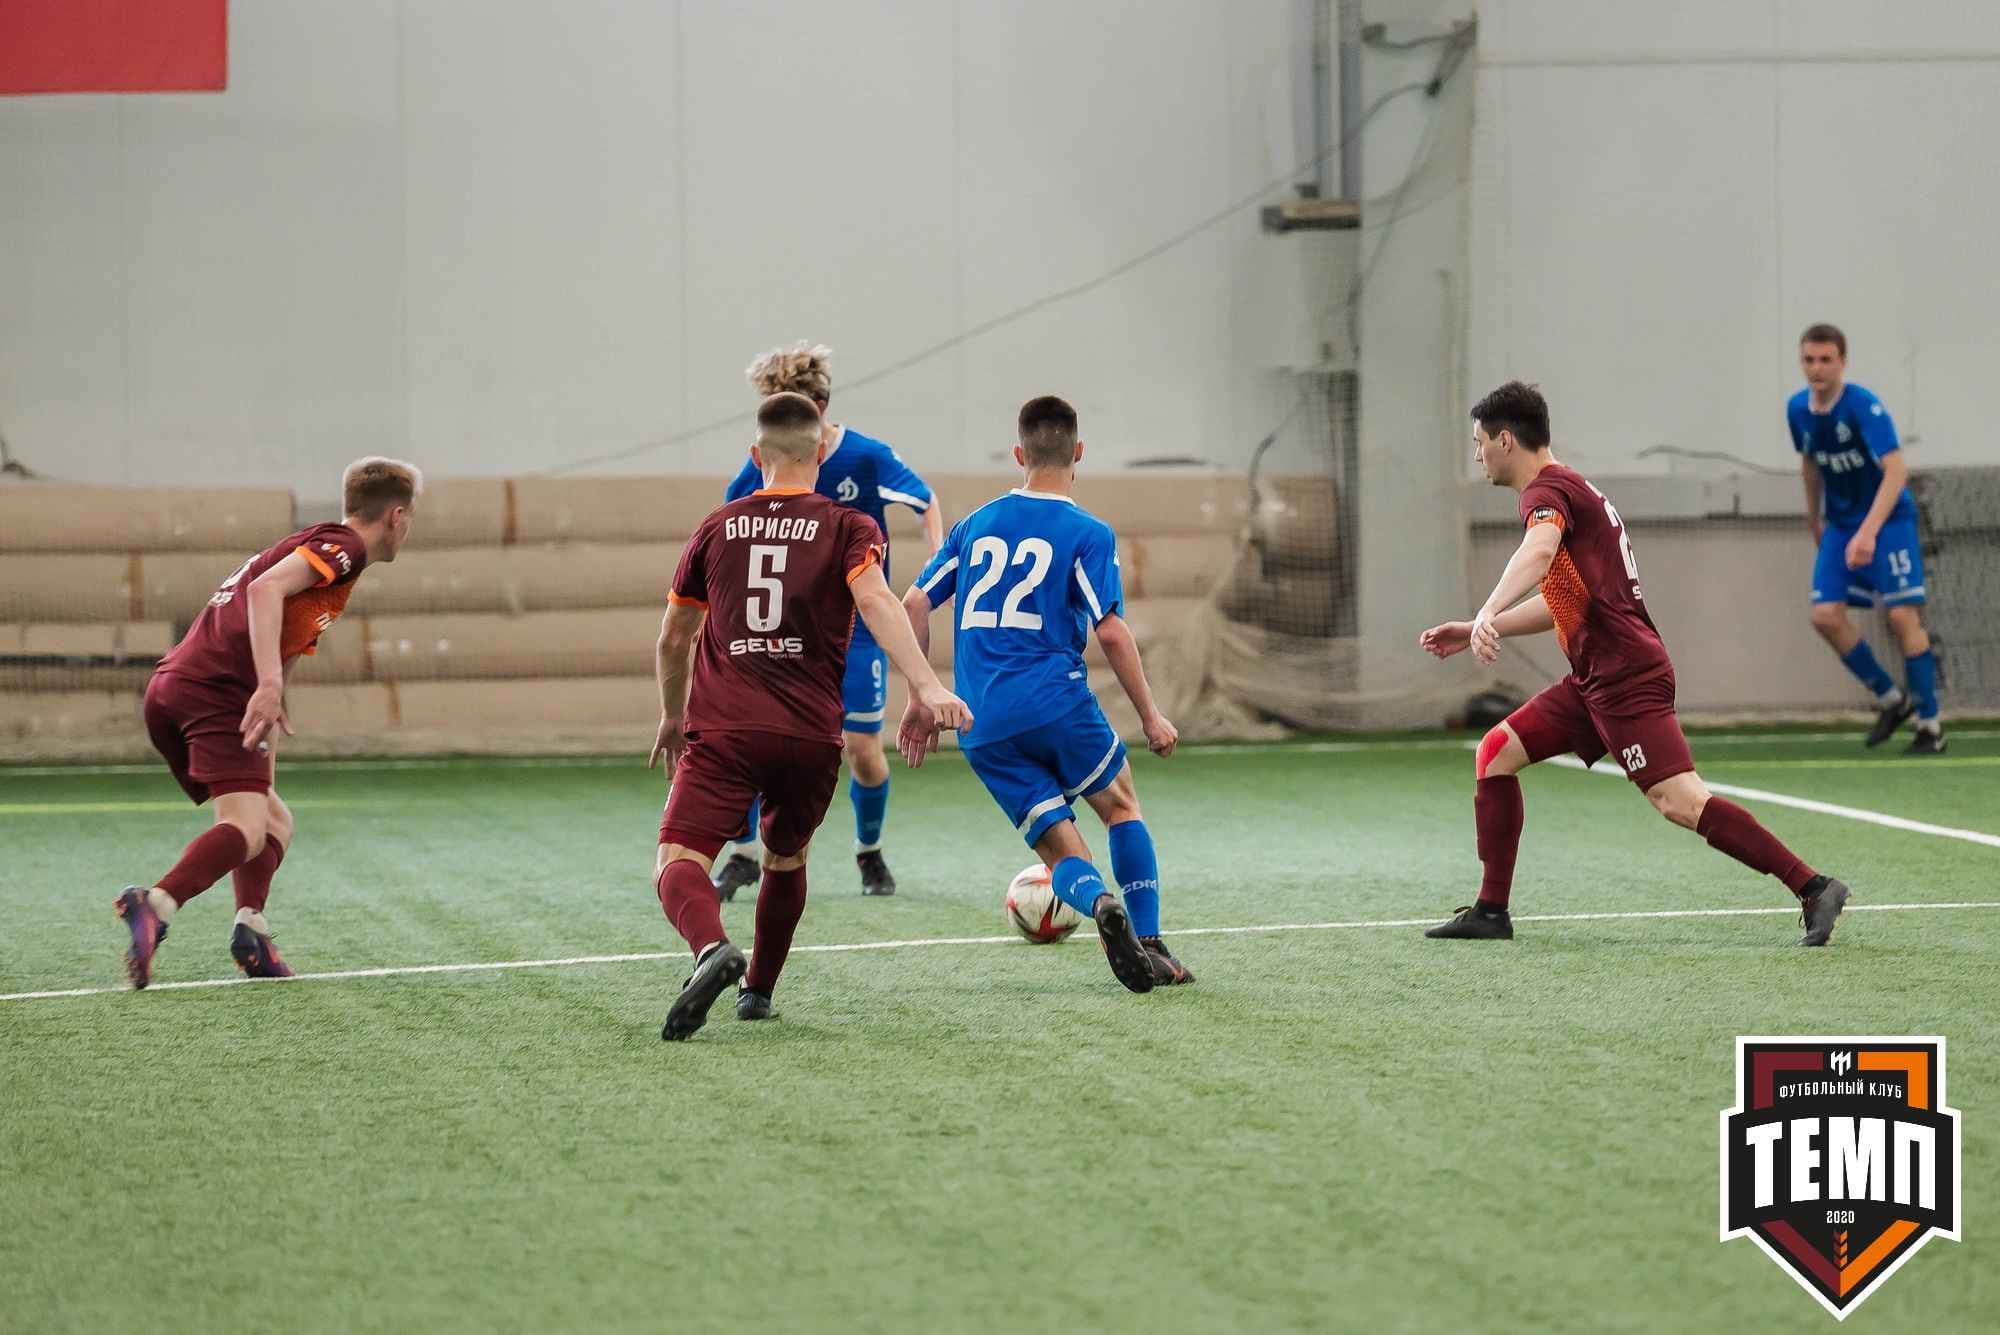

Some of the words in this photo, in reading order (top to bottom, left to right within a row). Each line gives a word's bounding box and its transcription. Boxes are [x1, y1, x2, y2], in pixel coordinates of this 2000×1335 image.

[725, 515, 820, 542] БОРИСОВ
[1888, 549, 1911, 576] 15
[746, 544, 788, 632] 5
[960, 535, 1053, 631] 22
[729, 637, 803, 656] SEUS
[872, 659, 882, 689] 9
[1622, 743, 1648, 772] 23
